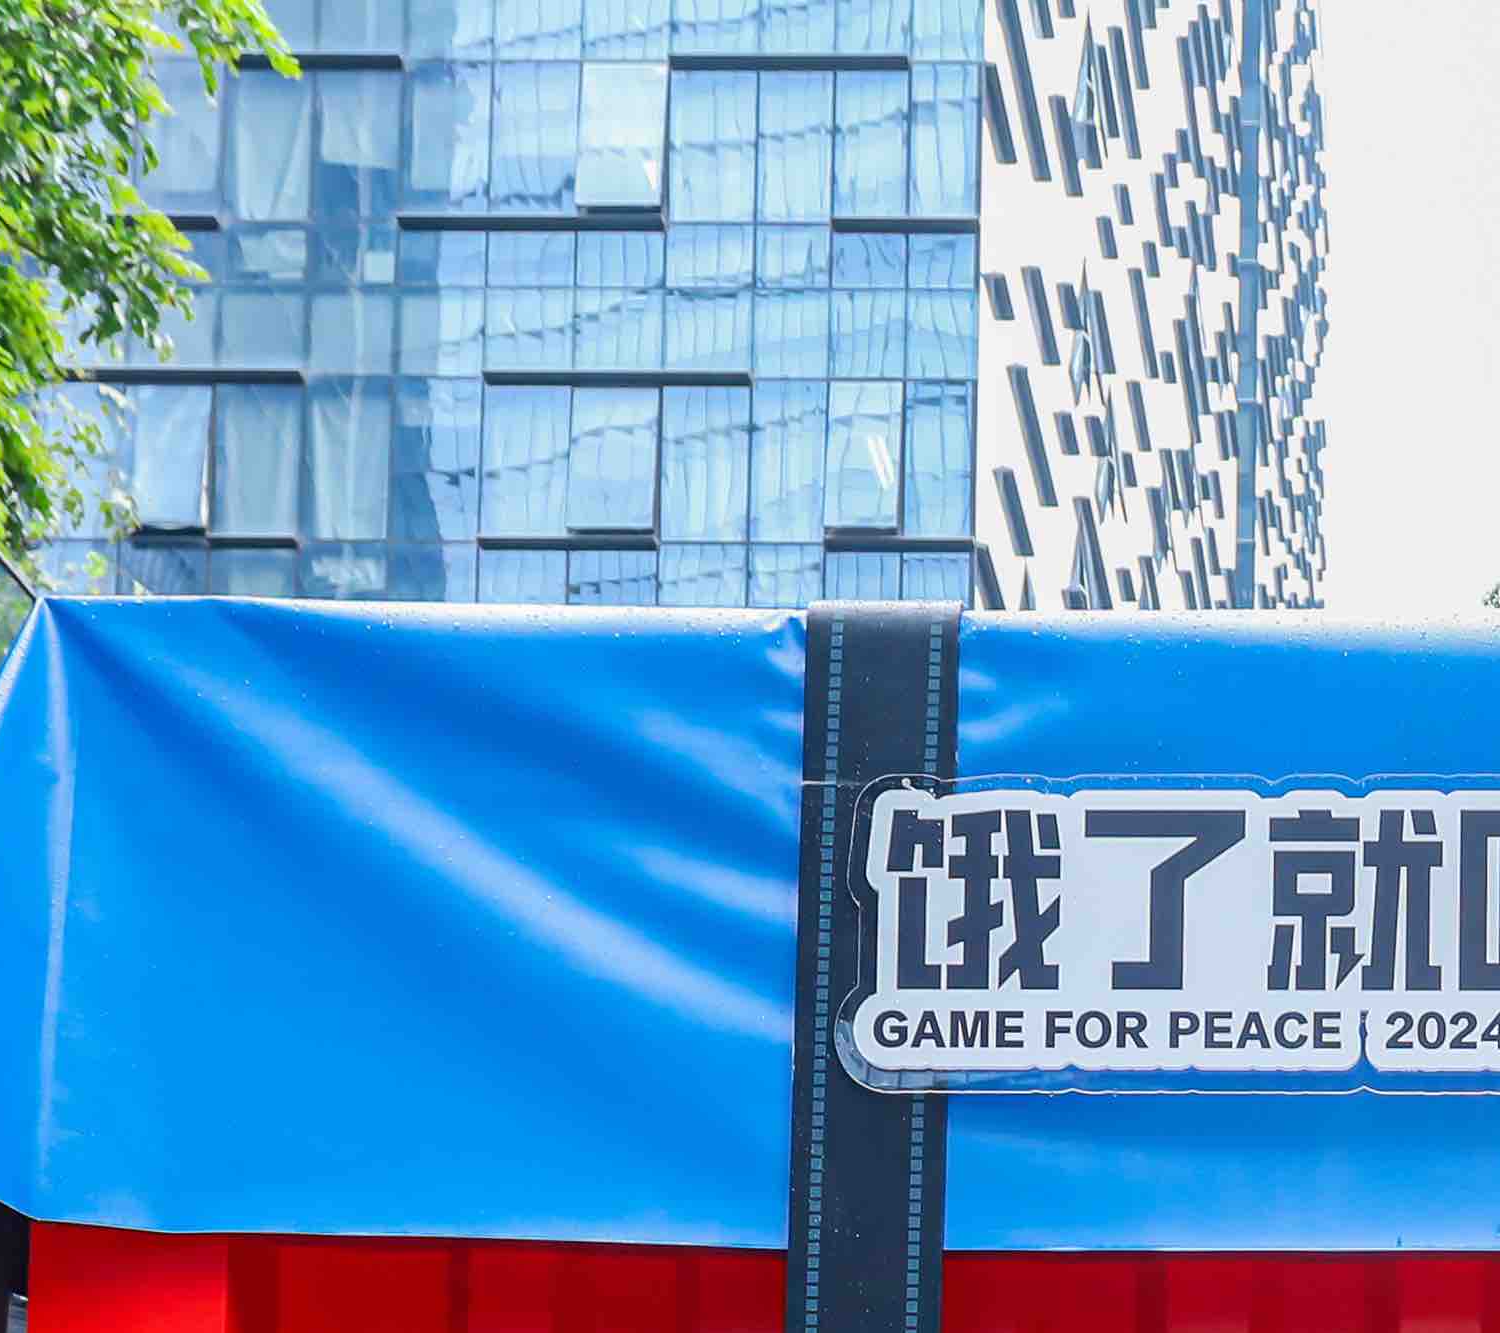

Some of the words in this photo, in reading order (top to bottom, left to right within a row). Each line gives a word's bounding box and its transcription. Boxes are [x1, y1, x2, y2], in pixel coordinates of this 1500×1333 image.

[872, 1010, 1028, 1051] GAME
[1043, 1010, 1144, 1050] FOR
[1167, 1010, 1343, 1051] PEACE
